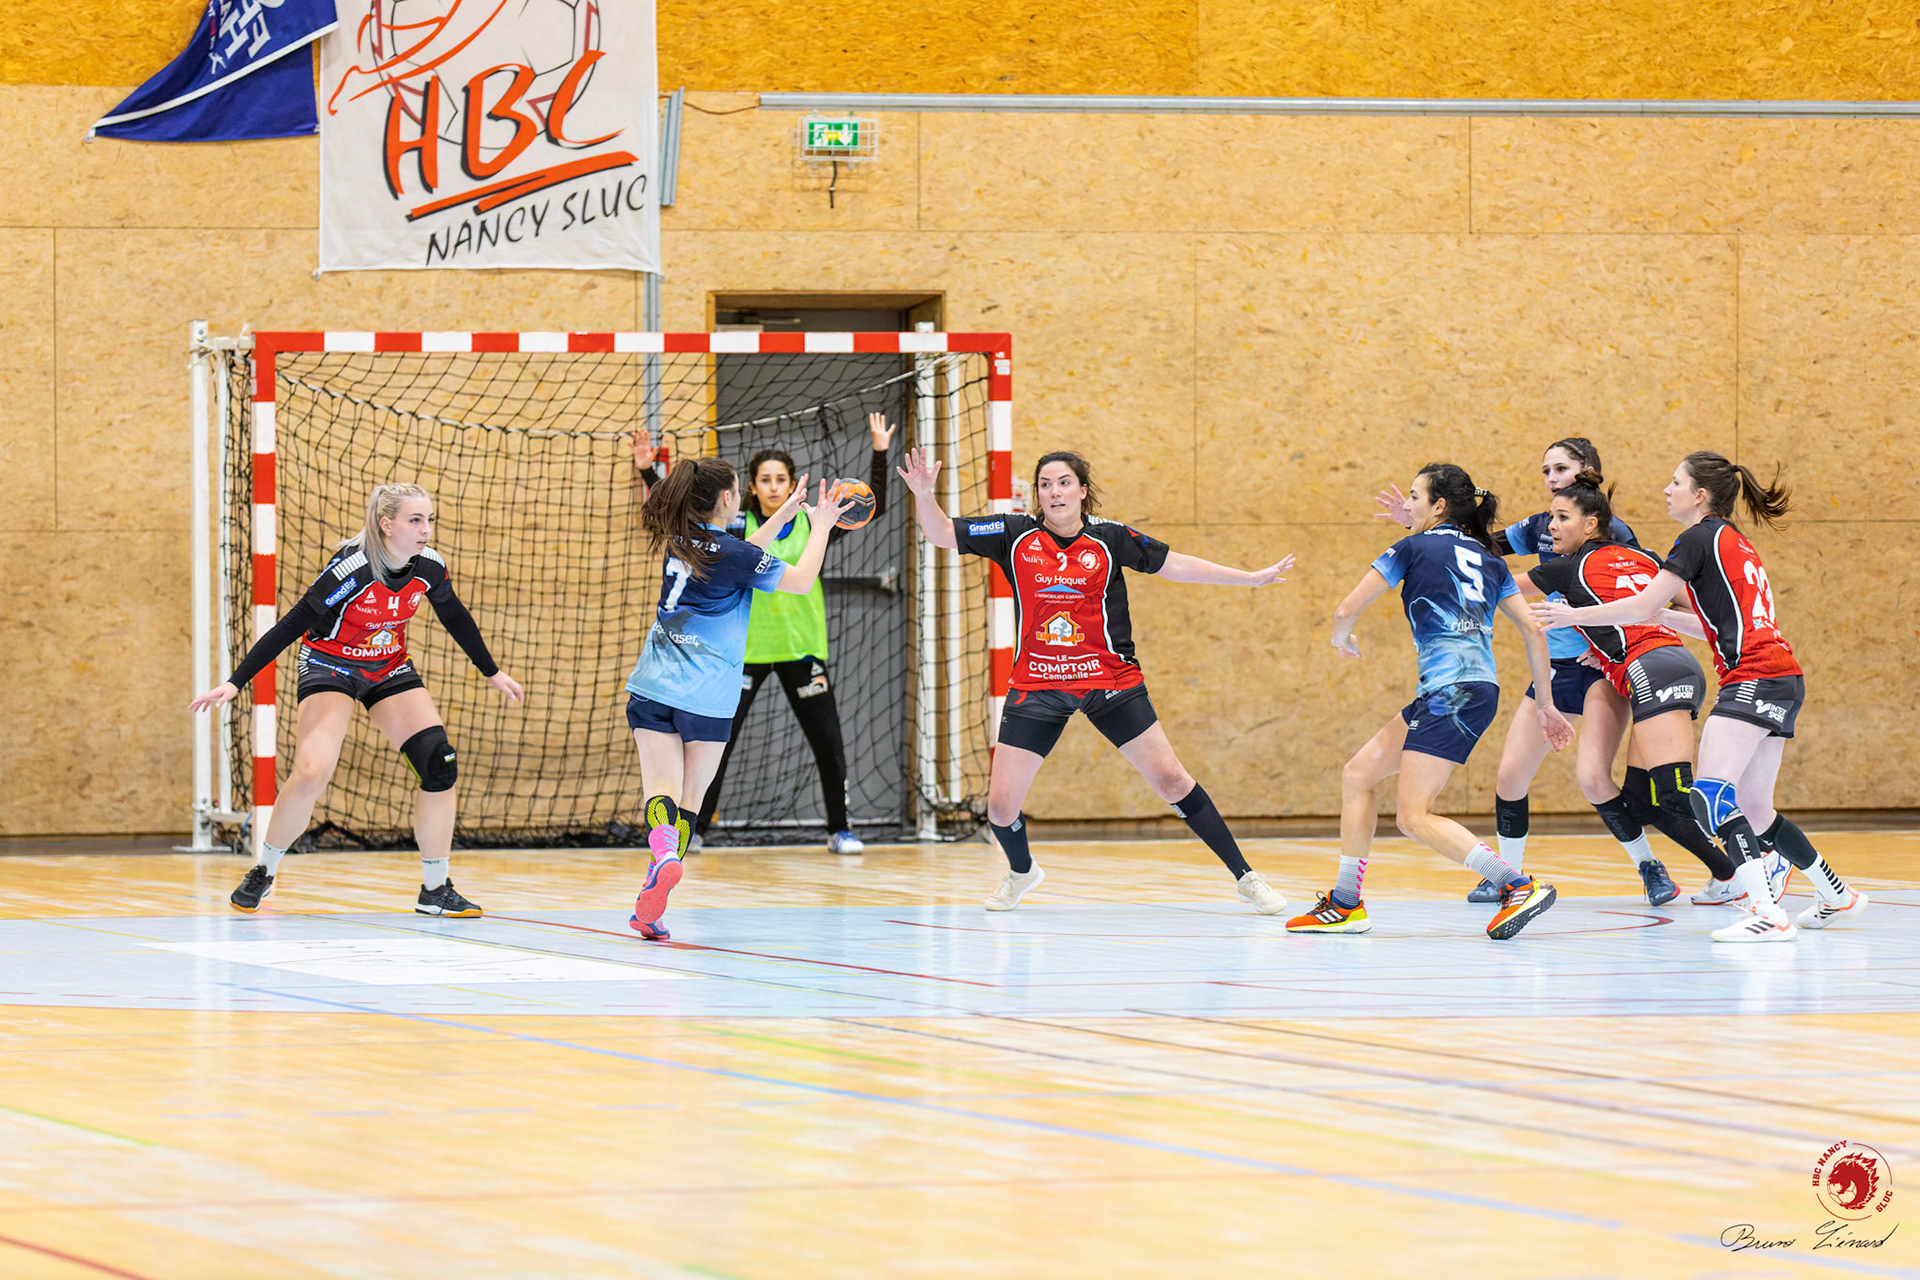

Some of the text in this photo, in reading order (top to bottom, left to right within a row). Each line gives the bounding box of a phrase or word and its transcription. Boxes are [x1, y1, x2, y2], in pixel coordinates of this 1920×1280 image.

[382, 49, 628, 201] HBC
[426, 174, 647, 266] NANCY SLUC
[1034, 573, 1088, 586] Guy Hoquet
[1453, 544, 1487, 603] 5
[665, 556, 693, 613] 7
[386, 596, 400, 617] 4
[1056, 654, 1068, 662] LE
[1028, 659, 1102, 674] COMPTOIR
[1042, 671, 1089, 682] Campanile
[1673, 684, 1694, 693] INTER
[1673, 691, 1694, 700] SPORT
[1769, 704, 1787, 718] INTER
